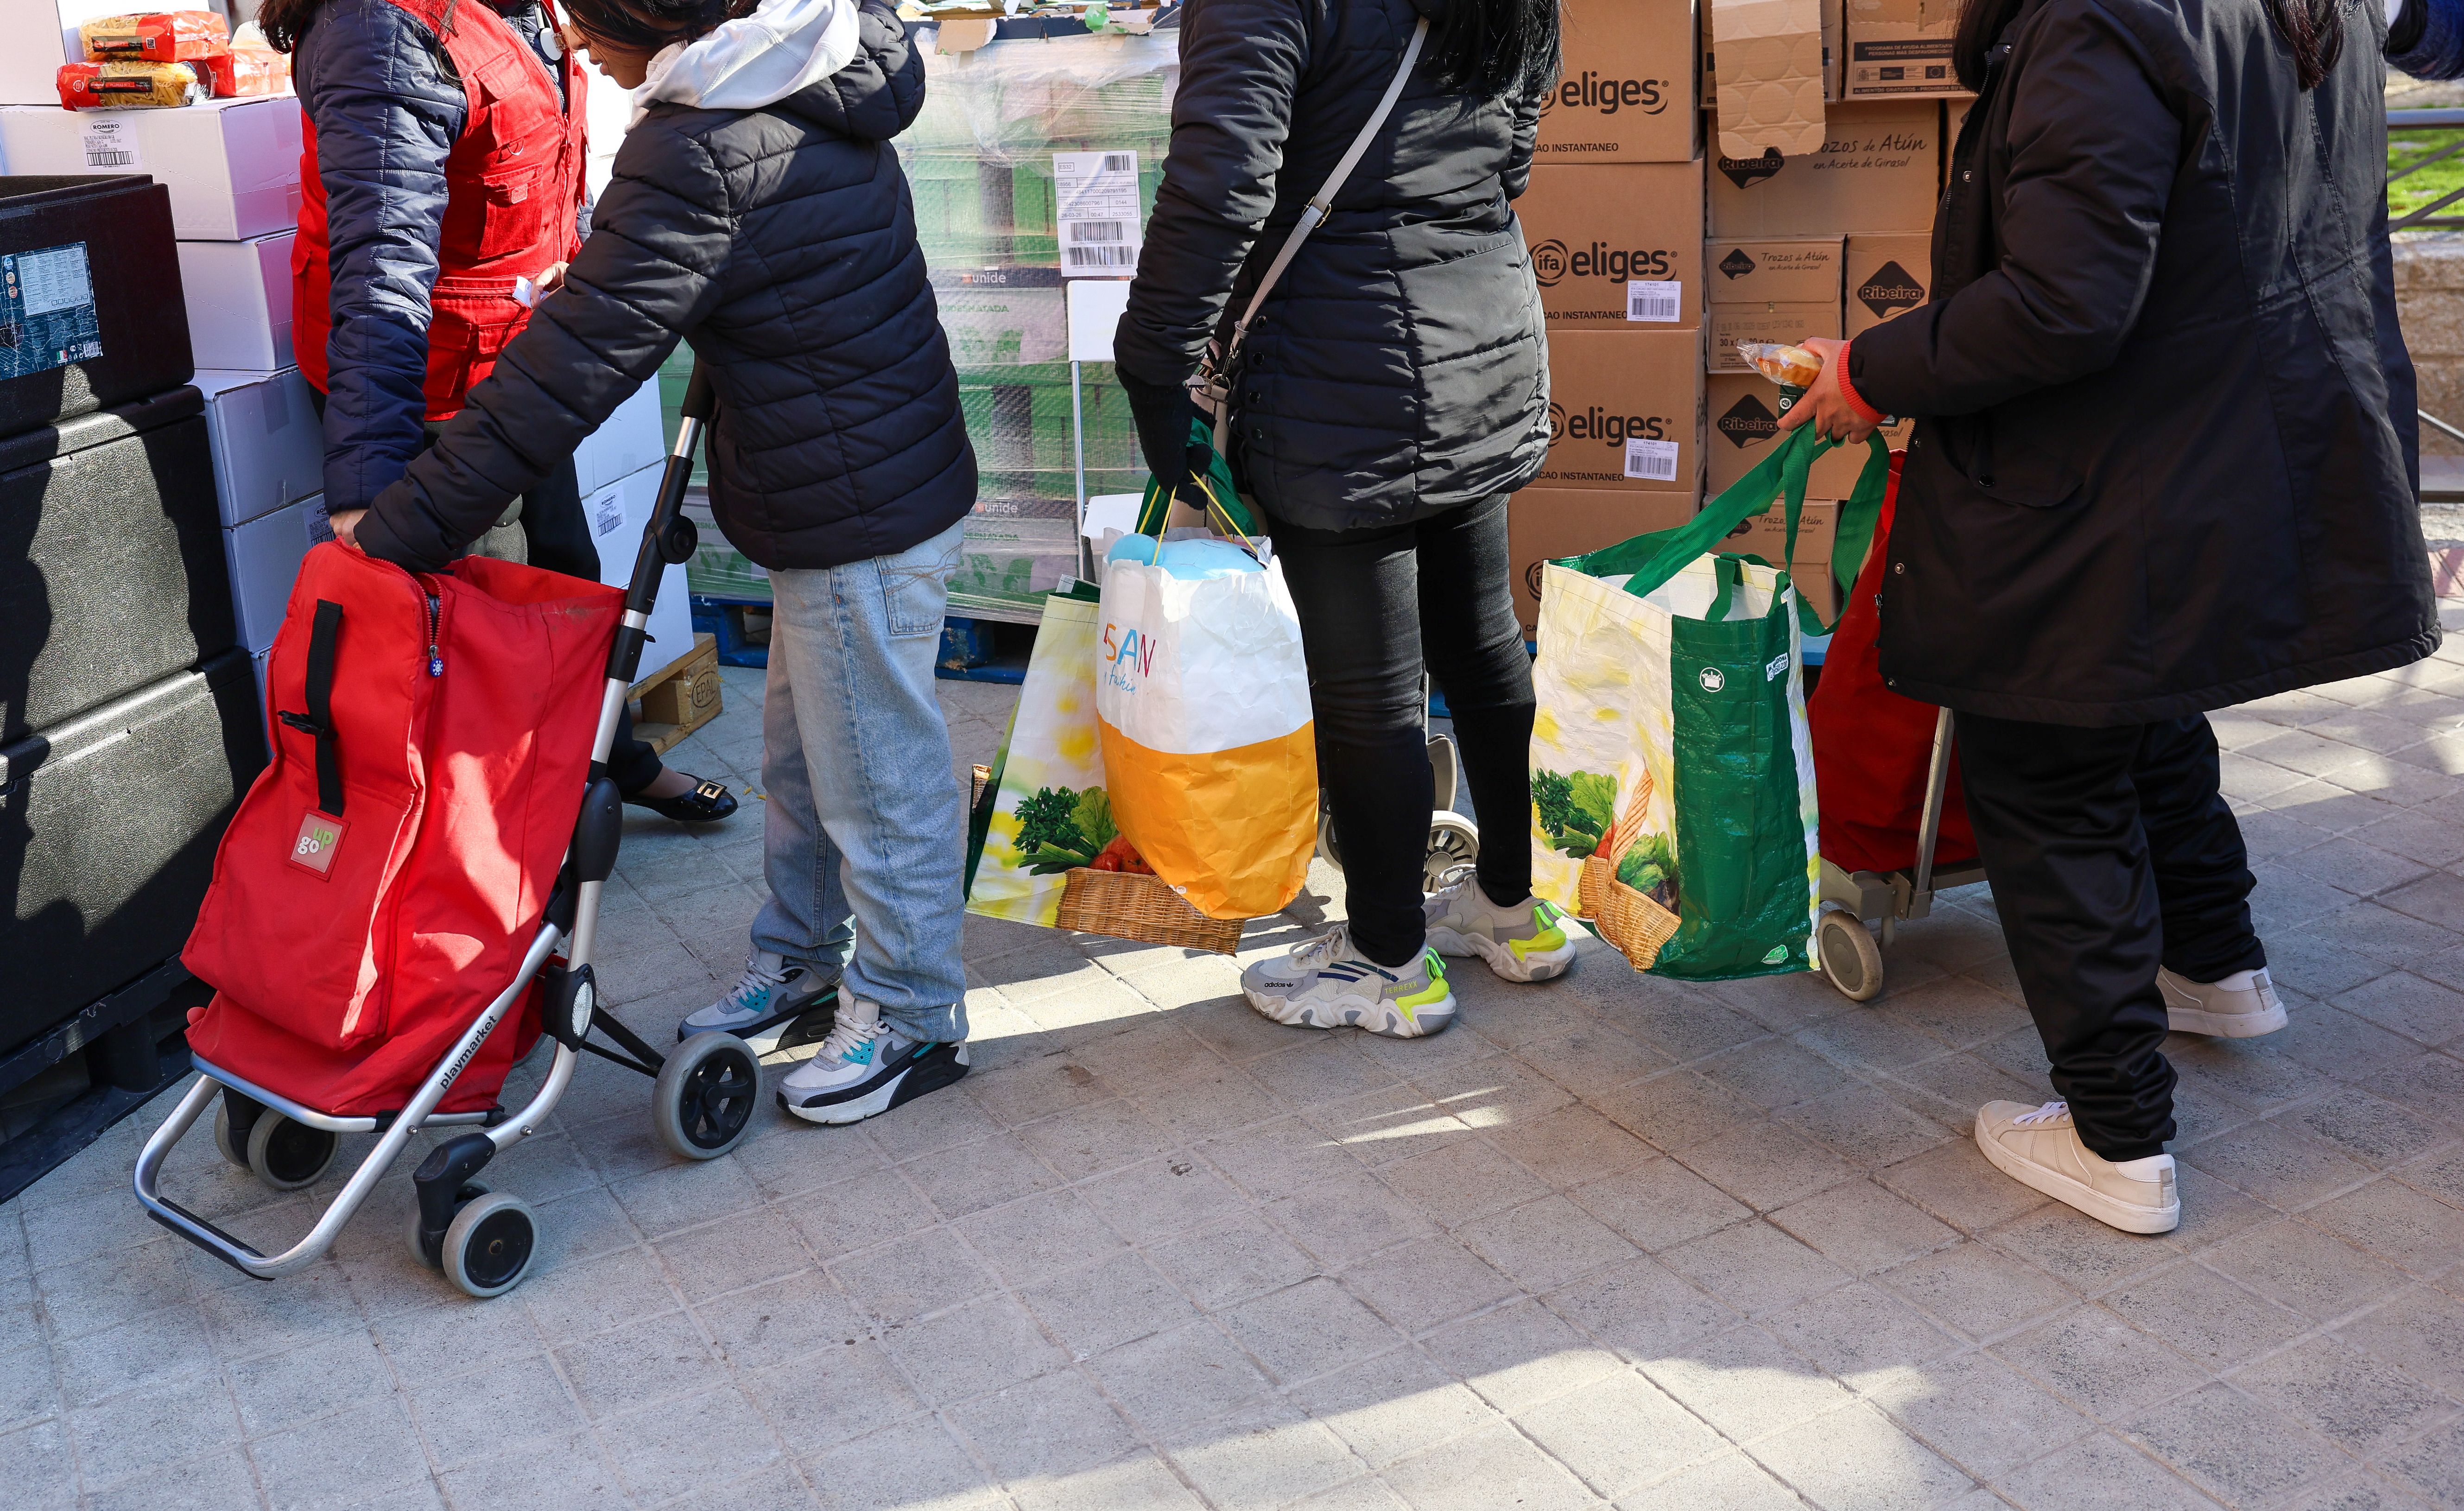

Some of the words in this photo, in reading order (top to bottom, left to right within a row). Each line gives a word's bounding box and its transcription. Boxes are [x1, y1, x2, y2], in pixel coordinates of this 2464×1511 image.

[1560, 70, 1660, 114] eliges
[1552, 142, 1618, 152] INSTANTANEO
[1821, 141, 1856, 153] ozos
[1863, 140, 1875, 151] de
[1880, 133, 1927, 151] Atún
[1827, 159, 1858, 169] Aceite
[1861, 159, 1871, 168] de
[1875, 156, 1910, 168] Girasol
[1538, 254, 1559, 270] ifa
[1571, 241, 1669, 284] eliges
[1761, 252, 1793, 261] Trozos
[1804, 251, 1830, 261] Atún
[1722, 261, 1755, 270] Ribeira
[972, 272, 1006, 283] unide
[1862, 286, 1922, 300] Ribeira
[1544, 311, 1560, 320] CAO
[1563, 311, 1627, 320] INSTANTANEO
[1568, 406, 1664, 448] eliges
[1722, 417, 1778, 432] Ribeira
[1560, 471, 1624, 481] INSTANTANEO
[601, 495, 616, 505] ROMERO
[984, 502, 1018, 513] unide
[696, 677, 716, 703] EPAL
[297, 836, 319, 855] go
[312, 827, 334, 850] up
[1384, 980, 1418, 995] TERREXX
[440, 1015, 497, 1090] playmarket
